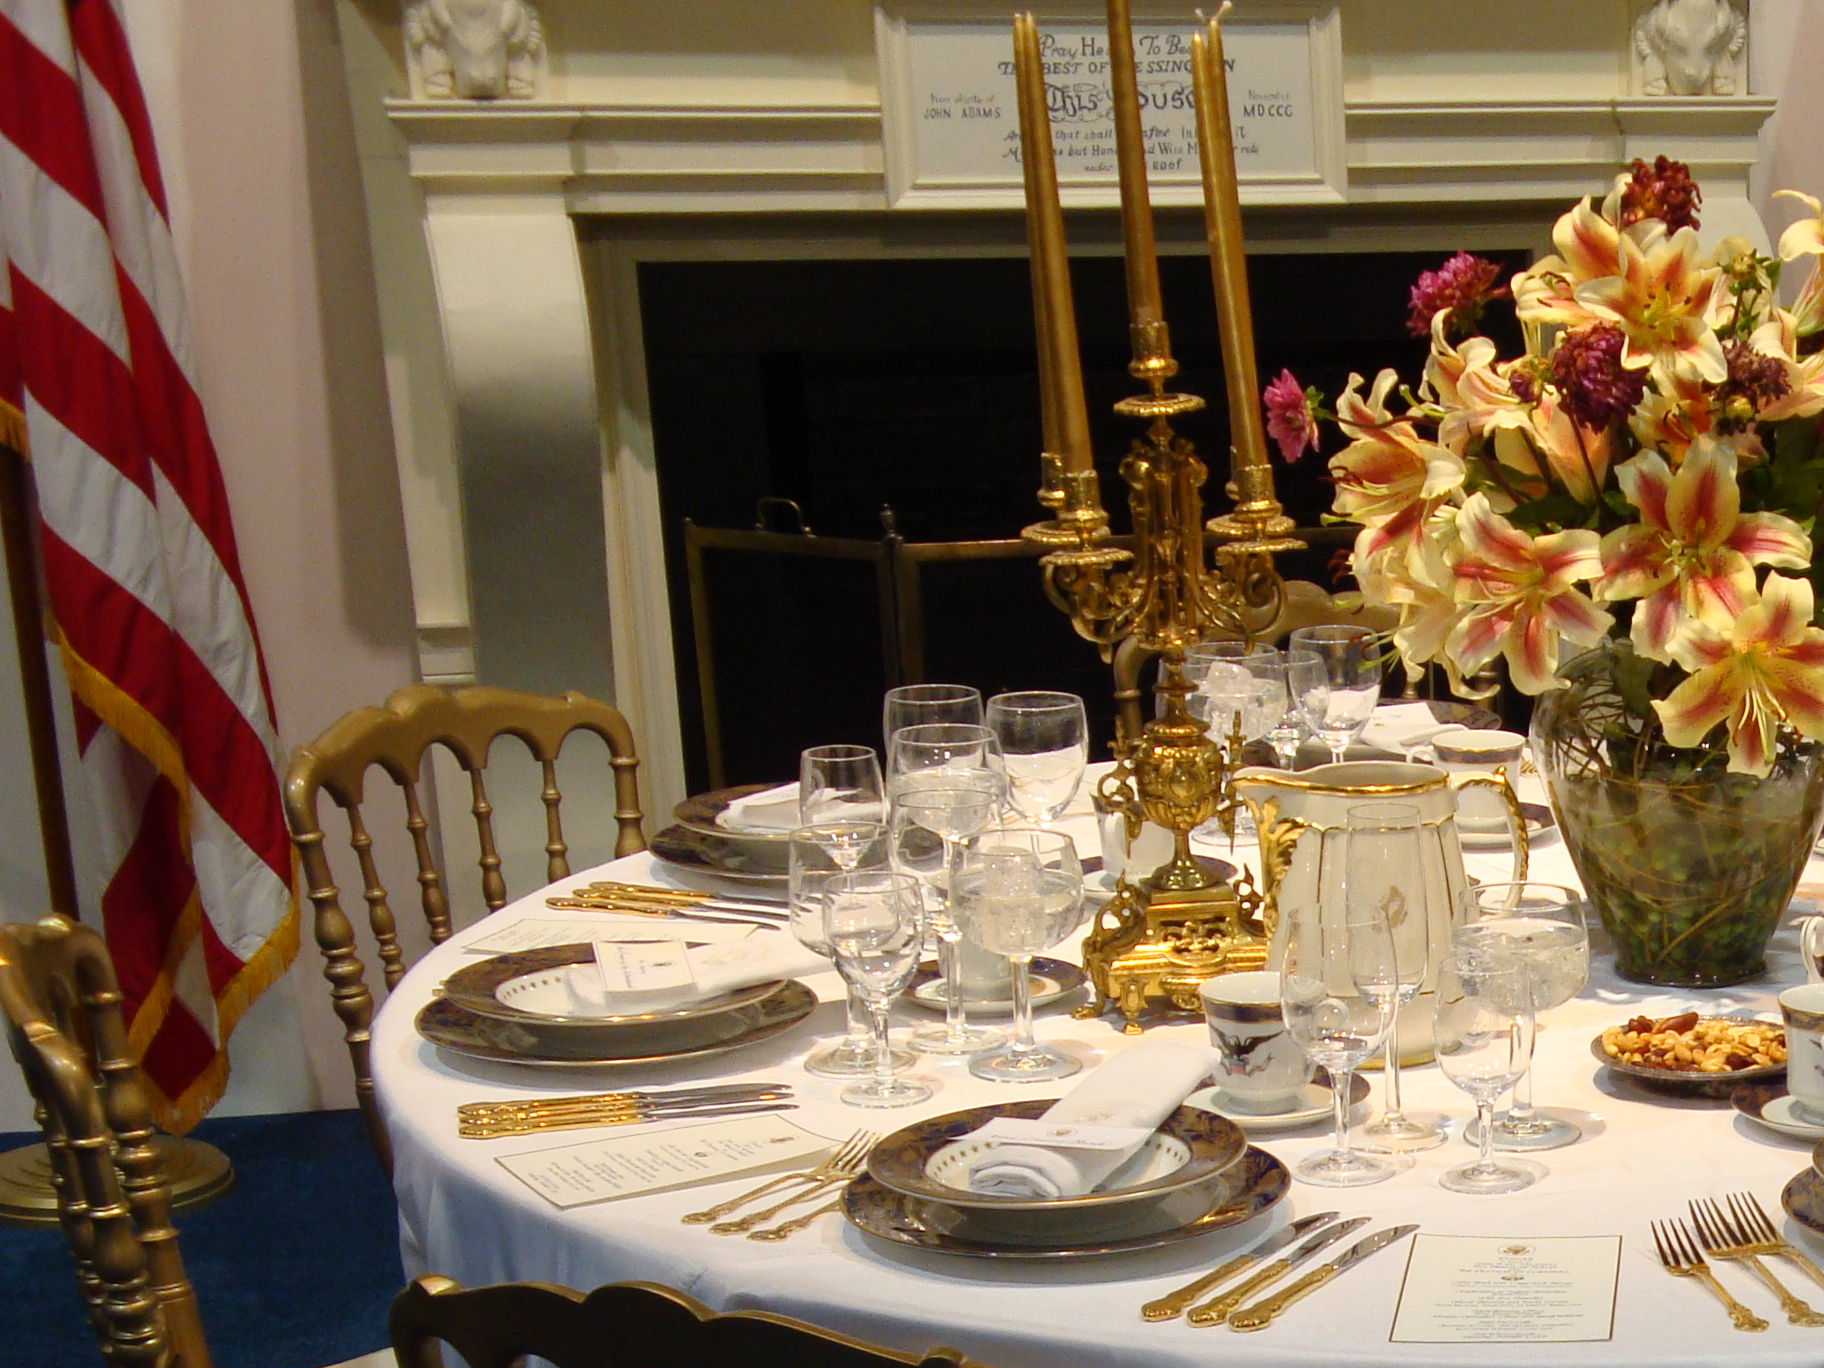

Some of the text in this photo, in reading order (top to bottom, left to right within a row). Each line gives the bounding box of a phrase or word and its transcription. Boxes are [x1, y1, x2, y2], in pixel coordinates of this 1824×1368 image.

[1039, 34, 1079, 60] Pray
[1139, 35, 1161, 56] To
[1042, 61, 1083, 74] BEST
[1088, 61, 1109, 74] OF
[922, 106, 1002, 119] JOHN ADAMS
[1243, 103, 1294, 118] MDCCC
[1055, 129, 1080, 141] that
[1084, 128, 1113, 139] shall
[1067, 145, 1087, 157] but
